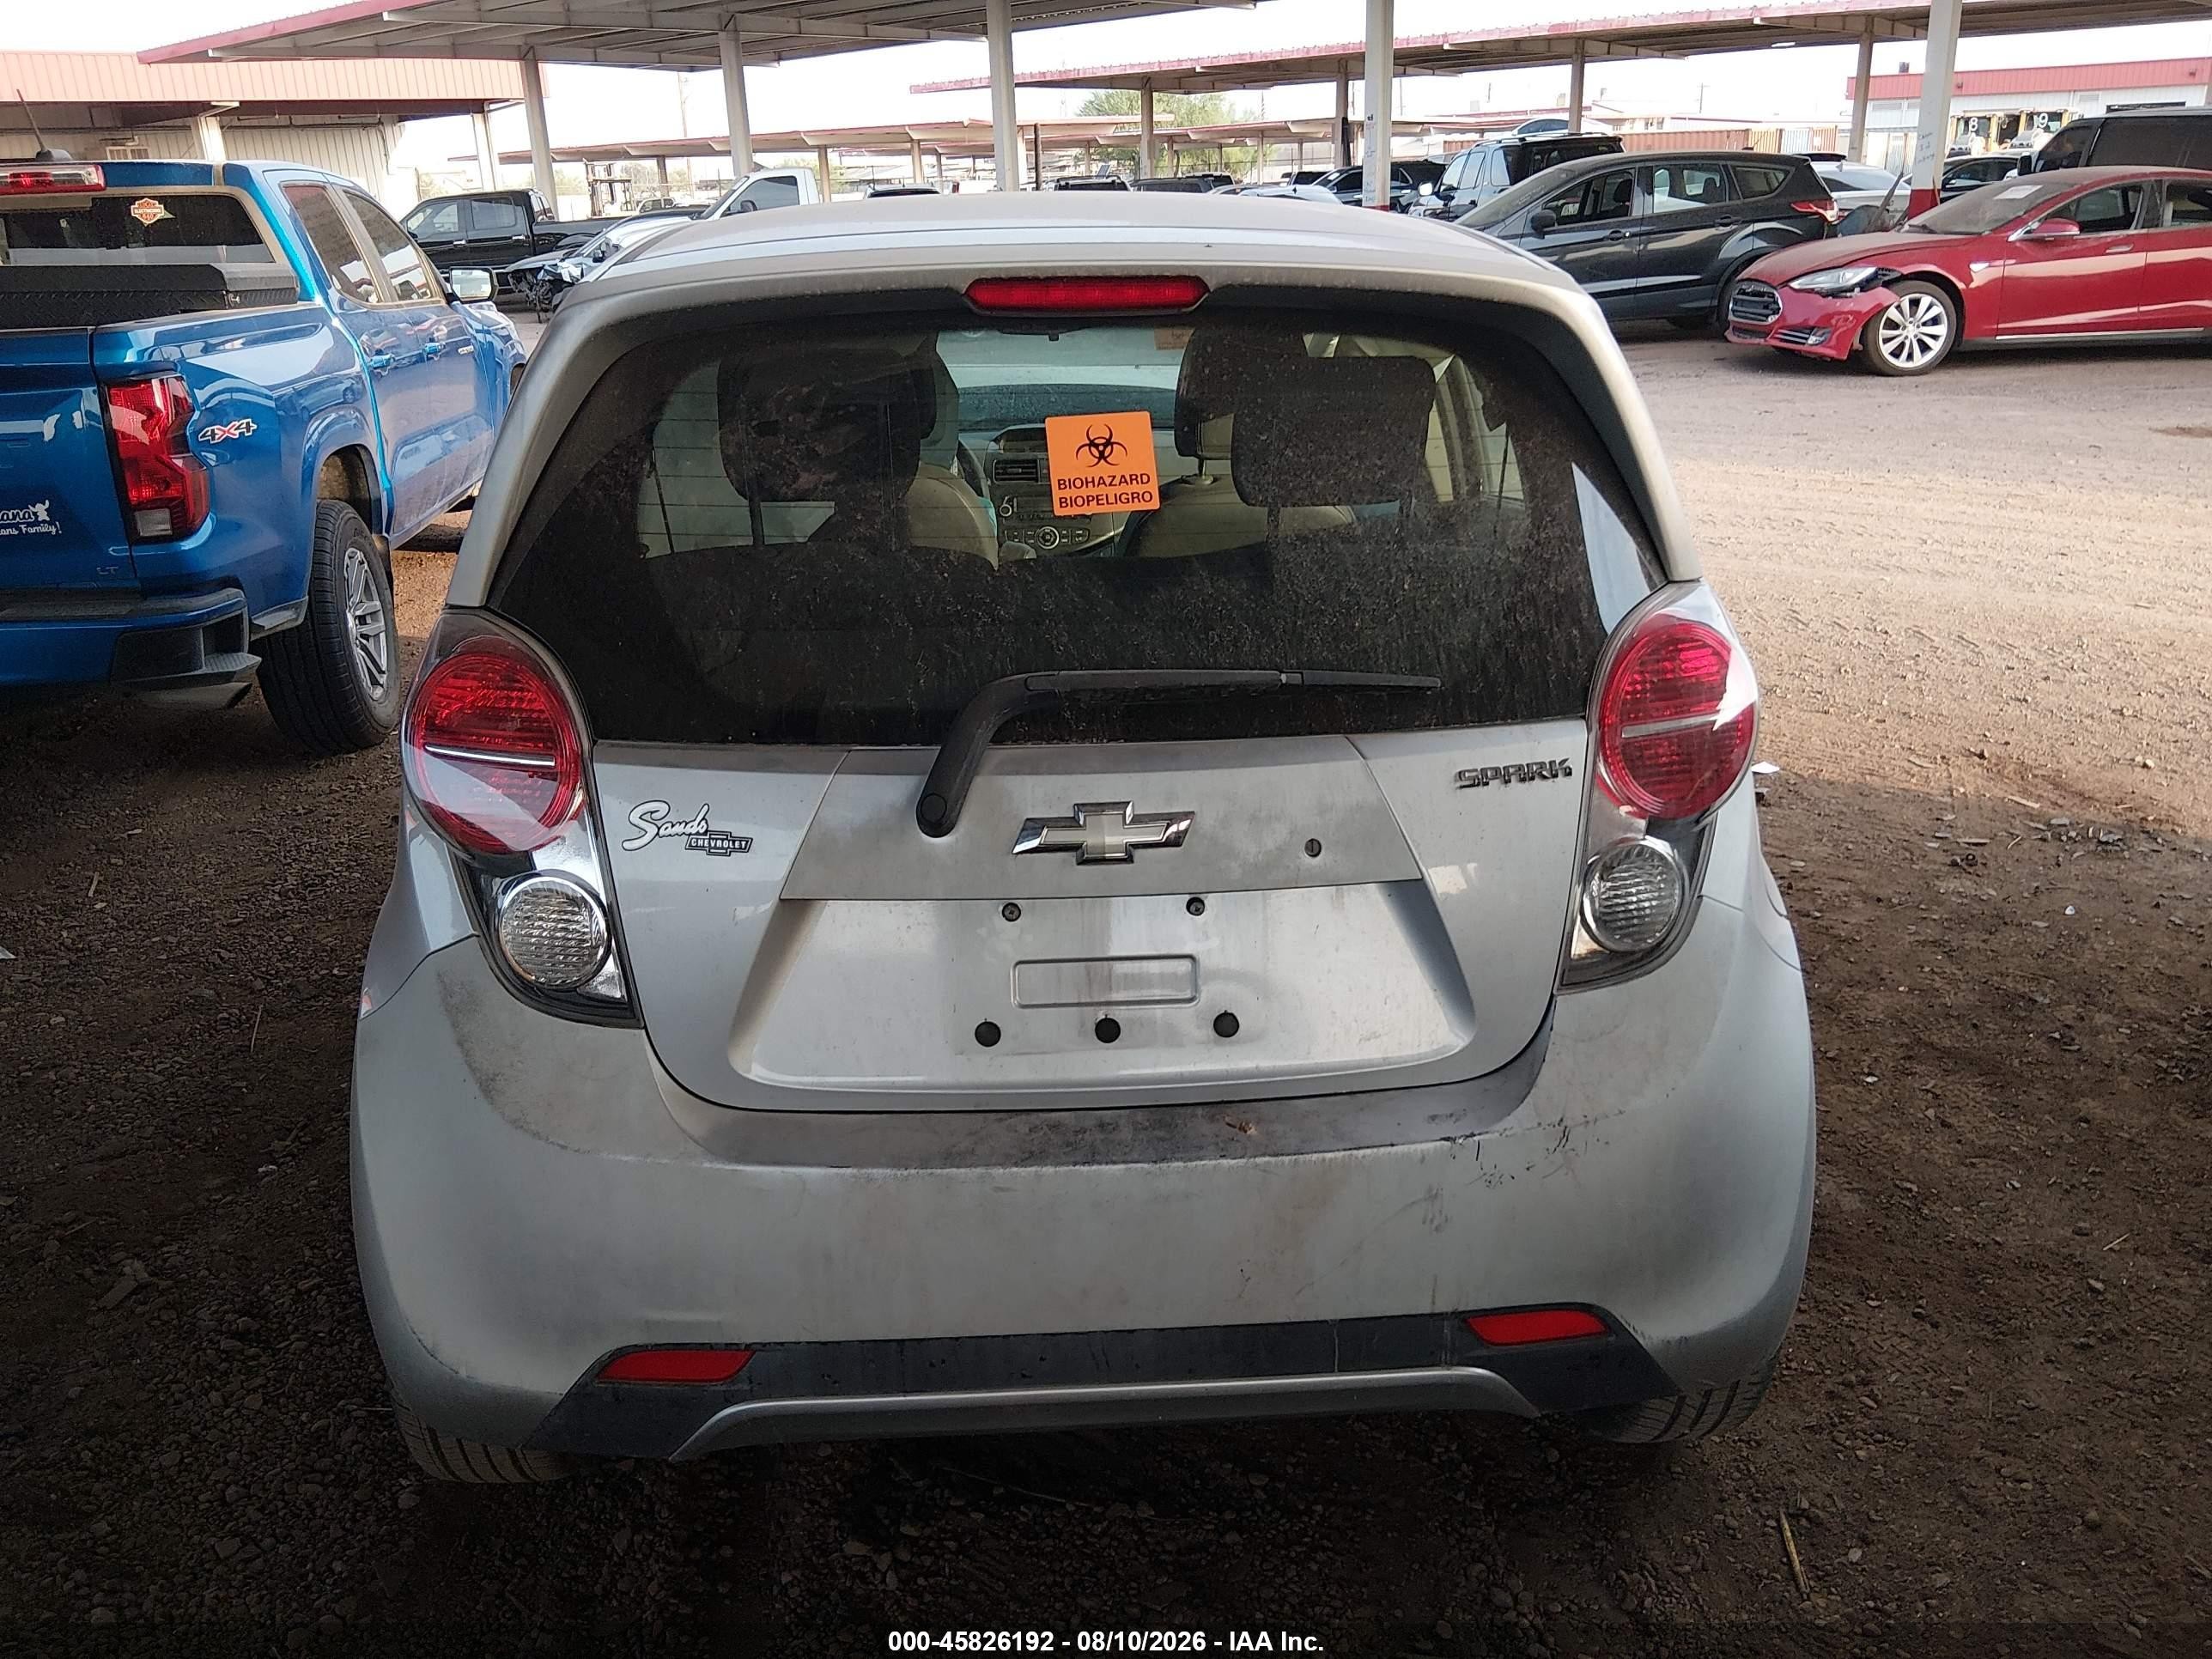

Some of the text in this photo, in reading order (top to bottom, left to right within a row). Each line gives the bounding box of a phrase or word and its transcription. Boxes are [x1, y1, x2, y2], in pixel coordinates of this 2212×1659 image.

[1970, 117, 1978, 131] 8
[2039, 112, 2049, 128] 9
[1057, 473, 1151, 490] BIOHAZARD
[1059, 490, 1153, 508] BIOPELIGRO
[19, 521, 62, 535] Family!
[1454, 757, 1573, 789] SPARK
[622, 799, 710, 851] Sands
[690, 837, 747, 849] CHEVROLET
